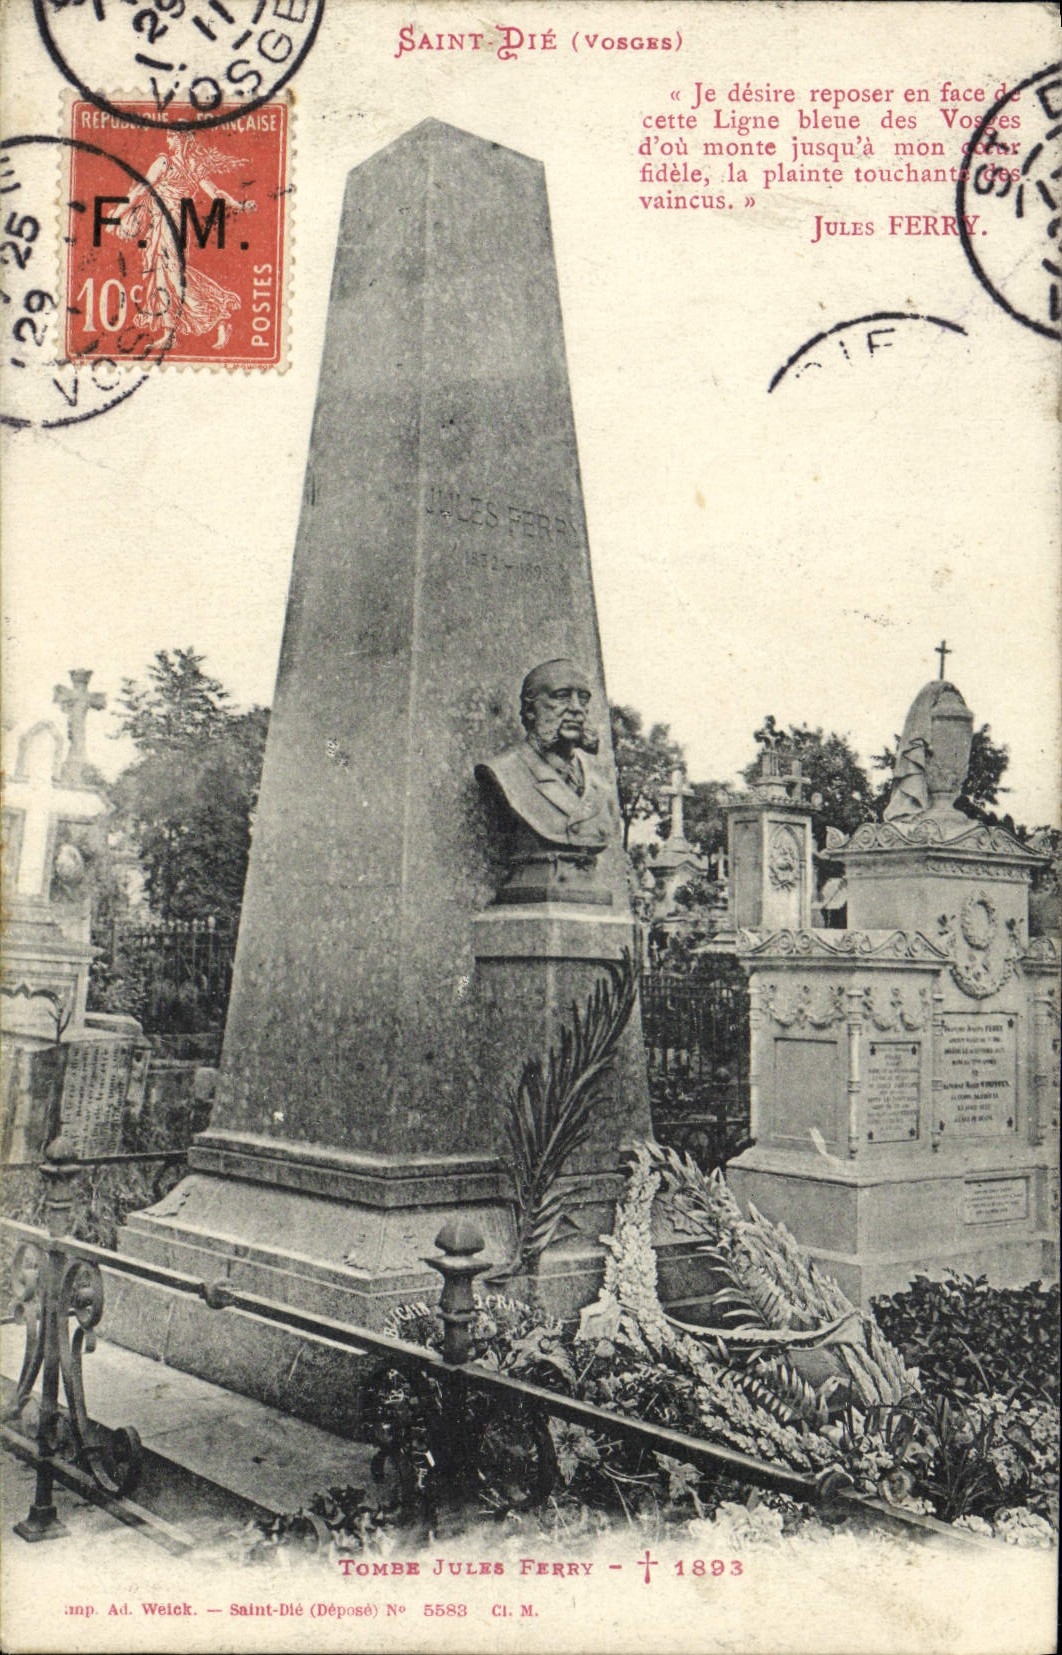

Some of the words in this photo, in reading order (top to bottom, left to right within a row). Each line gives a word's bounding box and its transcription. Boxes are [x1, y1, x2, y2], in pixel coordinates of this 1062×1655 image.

[149, 0, 308, 111] VOSGE
[81, 110, 169, 131] REPUBQUE
[251, 262, 273, 349] POSTES
